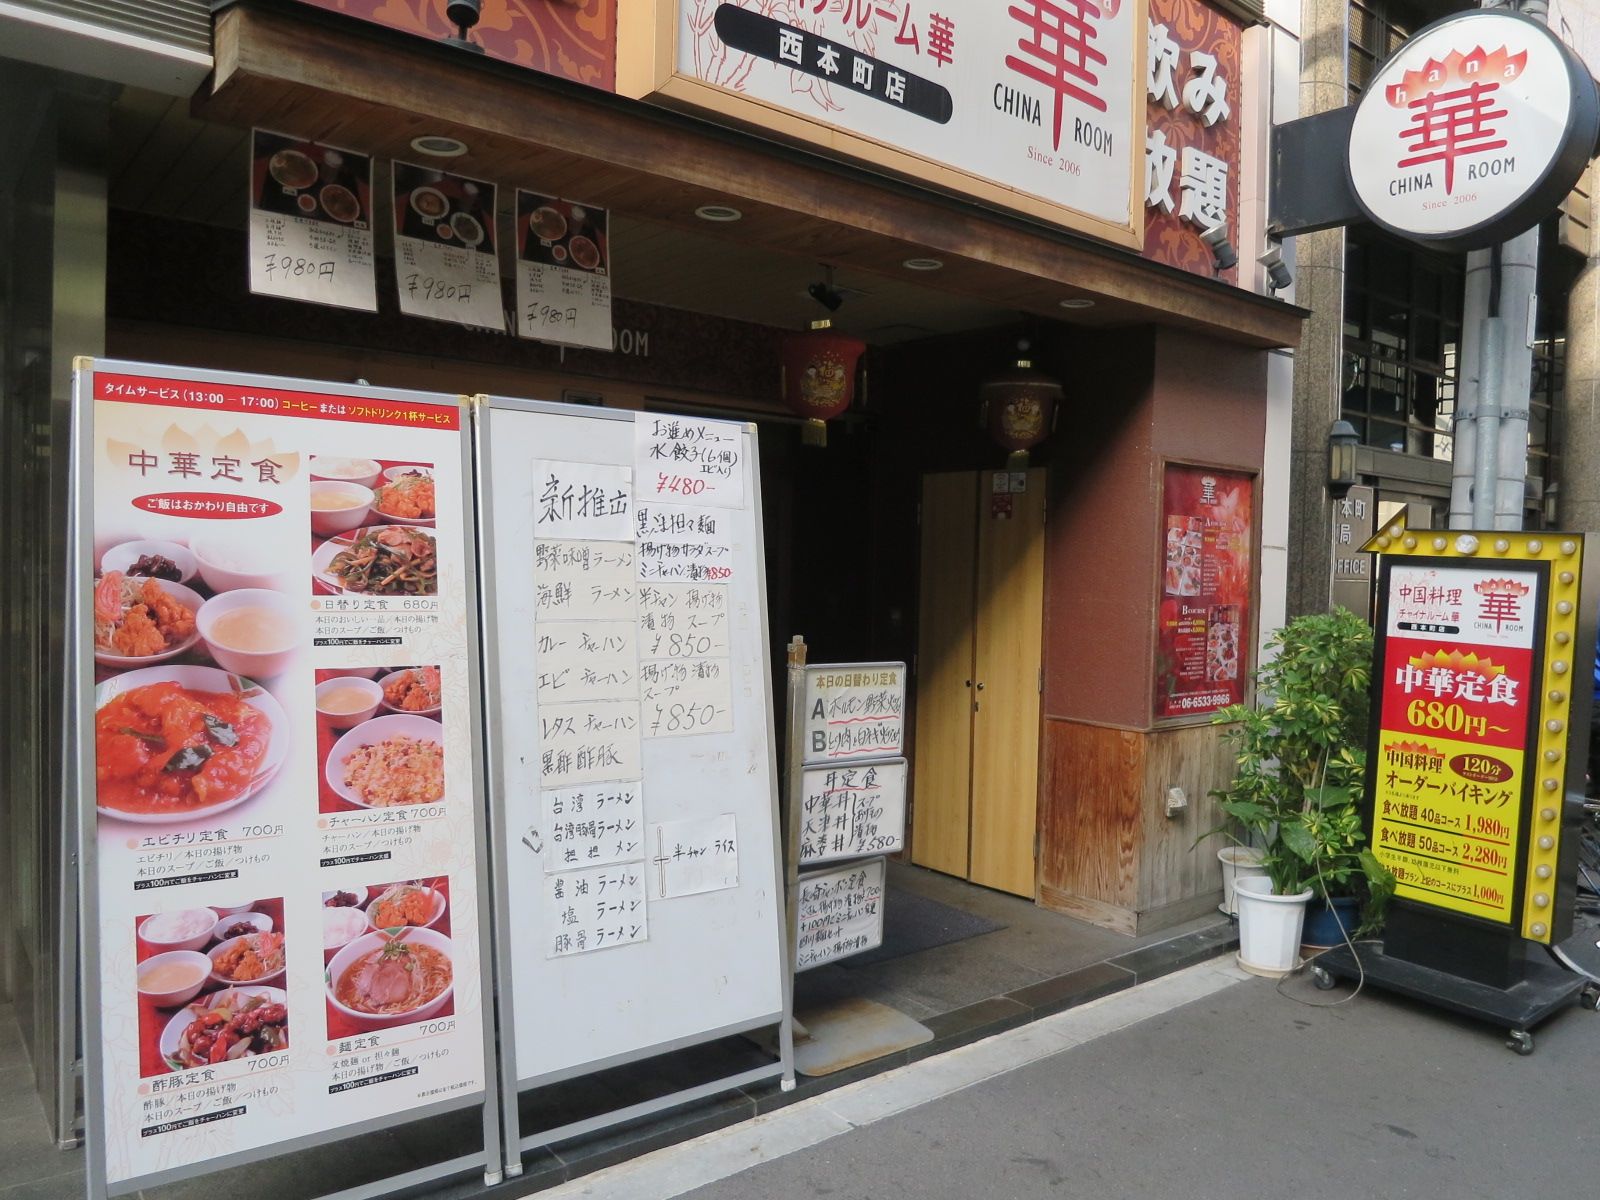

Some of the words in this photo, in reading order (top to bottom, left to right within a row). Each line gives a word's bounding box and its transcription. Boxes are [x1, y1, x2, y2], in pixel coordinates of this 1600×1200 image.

[778, 26, 907, 105] 西本町店
[993, 82, 1042, 127] CHINA
[1073, 115, 1114, 157] ROOM
[1397, 81, 1508, 196] 華
[1026, 144, 1054, 168] Since
[1058, 153, 1082, 177] 2006
[1389, 172, 1434, 197] CHINA
[1468, 156, 1516, 181] ROOM
[1421, 199, 1448, 211] Since
[1453, 192, 1478, 206] 2006
[104, 382, 180, 406] タイムサービス
[282, 401, 318, 412] コーヒー
[319, 403, 347, 415] または
[348, 407, 451, 424] ソフトドリンク1杯サービス
[128, 449, 284, 486] 中華定食
[147, 497, 269, 514] ご飯はおかわり自由です
[537, 473, 628, 524] 新推出
[594, 547, 633, 568] ラーメン
[1335, 558, 1367, 576] FFICE
[325, 599, 389, 611] 日替り定食
[403, 599, 439, 611] 680円
[537, 582, 573, 609] 海鮮
[591, 584, 637, 603] ラーメン
[1399, 584, 1463, 606] 中国料理
[686, 612, 726, 630] スープ
[1478, 592, 1521, 635] 華
[1473, 622, 1493, 631] CHINA
[1505, 624, 1524, 633] ROOM
[538, 635, 568, 654] カレー
[538, 667, 571, 690] エビ
[815, 671, 898, 689] 本日の日替わり定食
[1395, 663, 1520, 707] 中華定食
[643, 685, 680, 701] スープ
[810, 697, 826, 720] A
[542, 715, 577, 741] レタス
[812, 729, 827, 753] B
[1386, 750, 1443, 774] 中国料理
[1462, 756, 1501, 776] 120分
[1385, 770, 1514, 809] オーダーバイキング
[553, 793, 585, 816] 台湾
[596, 792, 635, 810] ラーメン
[329, 809, 408, 828] チャーハン定食
[410, 807, 447, 819] 700円
[1383, 799, 1418, 821] 食べ放題
[1420, 807, 1461, 828] 40品コース
[1464, 814, 1510, 840] 1,980円
[142, 828, 229, 848] エビチリ定食
[242, 824, 285, 838] 700円
[1381, 826, 1416, 849] 食べ放題
[1418, 835, 1459, 857] 50品コース
[1462, 843, 1508, 870] 2,280円
[597, 873, 638, 896] ラーメン
[1473, 883, 1505, 905] 1,000円
[561, 905, 580, 926] 塩
[596, 899, 642, 921] ラーメン
[554, 930, 587, 953] 豚骨
[596, 923, 643, 946] ラーメン
[419, 1019, 456, 1036] 700円
[361, 1056, 372, 1065] or
[151, 1068, 216, 1093] 酢豚定食
[246, 1053, 290, 1072] 700円
